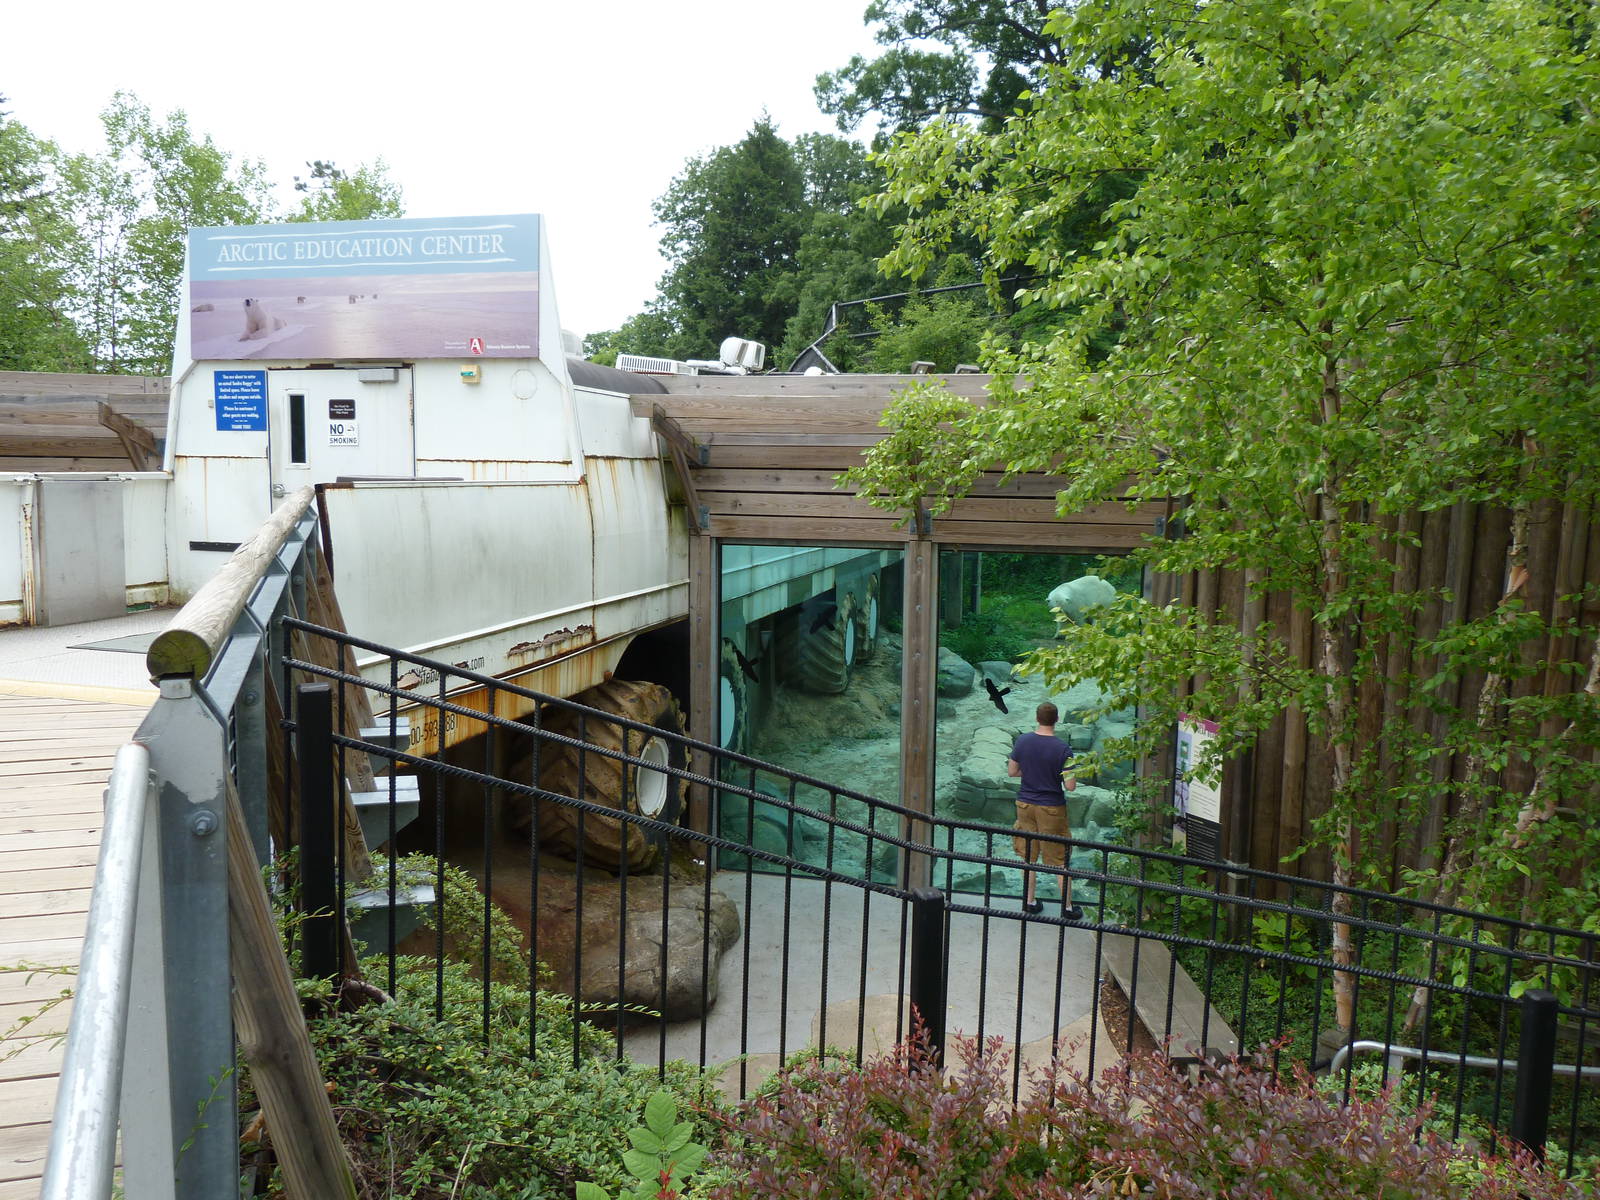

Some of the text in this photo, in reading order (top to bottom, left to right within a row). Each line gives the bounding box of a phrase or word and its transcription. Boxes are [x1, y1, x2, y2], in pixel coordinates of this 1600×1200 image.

[217, 233, 505, 262] ARCTIC EDUCATION CENTER
[330, 424, 343, 434] NO
